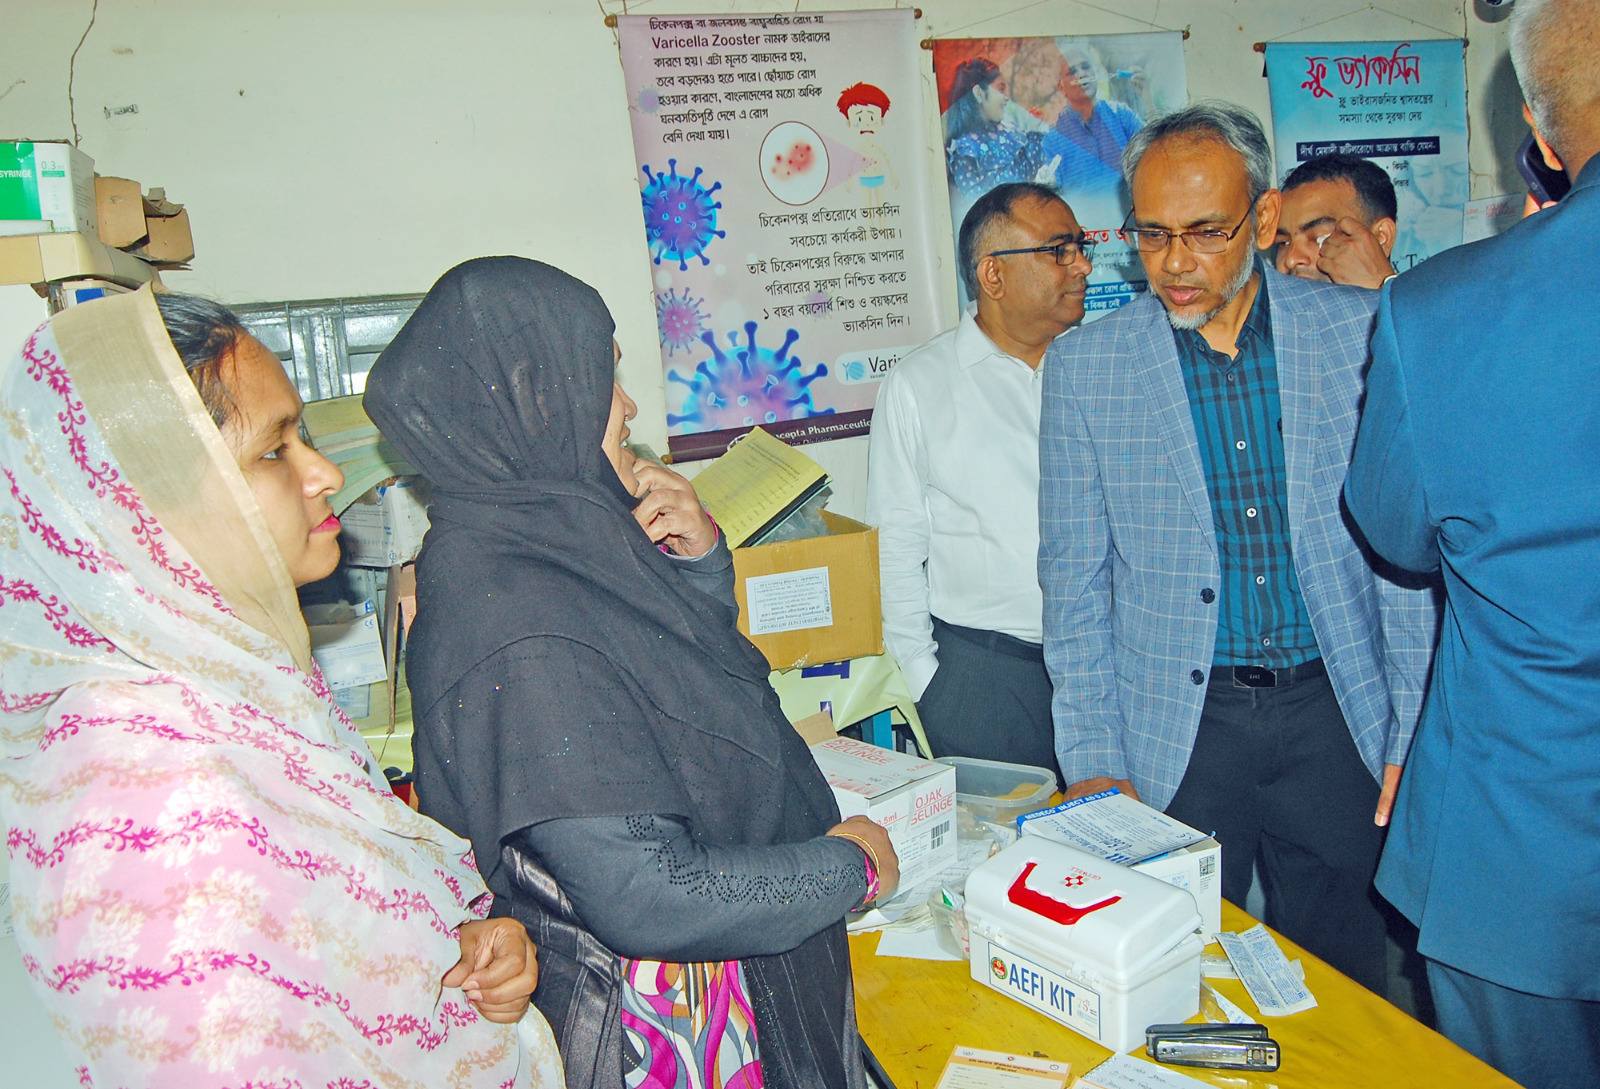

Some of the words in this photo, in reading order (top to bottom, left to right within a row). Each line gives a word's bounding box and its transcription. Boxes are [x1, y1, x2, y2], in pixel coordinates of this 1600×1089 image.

[695, 19, 706, 28] বা
[793, 16, 812, 25] রোগ
[652, 35, 709, 49] Varicella
[712, 33, 760, 47] Zooster
[763, 33, 788, 44] নামক
[791, 30, 831, 43] ভাইরাসের
[654, 57, 682, 68] কারণে
[706, 52, 722, 65] এটা
[725, 54, 748, 67] মূলত
[751, 52, 787, 63] বাচ্চাদের
[1333, 43, 1421, 88] ভ্যাকসিন
[656, 76, 675, 87] তবে
[677, 74, 715, 86] বড়দেরও
[717, 73, 735, 84] হতে
[797, 69, 817, 79] রোগ
[658, 94, 688, 106] হওয়ার
[724, 89, 773, 102] বাংলাদেশের
[775, 88, 796, 99] মতো
[798, 84, 823, 97] অধিক
[717, 110, 736, 120] দেশে
[739, 110, 747, 119] এ
[749, 108, 769, 119] রোগ
[663, 129, 683, 143] বেশি
[686, 130, 705, 141] দেখা
[759, 211, 809, 228] চিকেনপক্স
[811, 206, 857, 223] প্রতিরোধে
[859, 202, 900, 219] ভ্যাকসিন
[789, 233, 827, 247] সবচেয়ে
[830, 226, 867, 244] কার্যকরী
[746, 260, 767, 274] তাই
[770, 257, 830, 272] চিকেনপক্সের
[833, 251, 866, 267] বিরুদ্ধে
[868, 249, 904, 262] আপনার
[765, 280, 811, 296] পরিবারের
[813, 277, 841, 293] সুরক্ষা
[844, 272, 876, 288] নিশ্চিত
[877, 271, 907, 284] করতে
[773, 305, 794, 318] বছর
[835, 296, 855, 311] শিশু
[859, 298, 867, 308] ও
[869, 293, 909, 307] বয়স্কদের
[842, 315, 884, 332] ভ্যাকসিন
[868, 354, 901, 373] Vari
[775, 429, 806, 441] cepta
[808, 418, 872, 435] Pharmaceutic
[1009, 963, 1044, 1001] AEFI
[1050, 981, 1075, 1016] KIT
